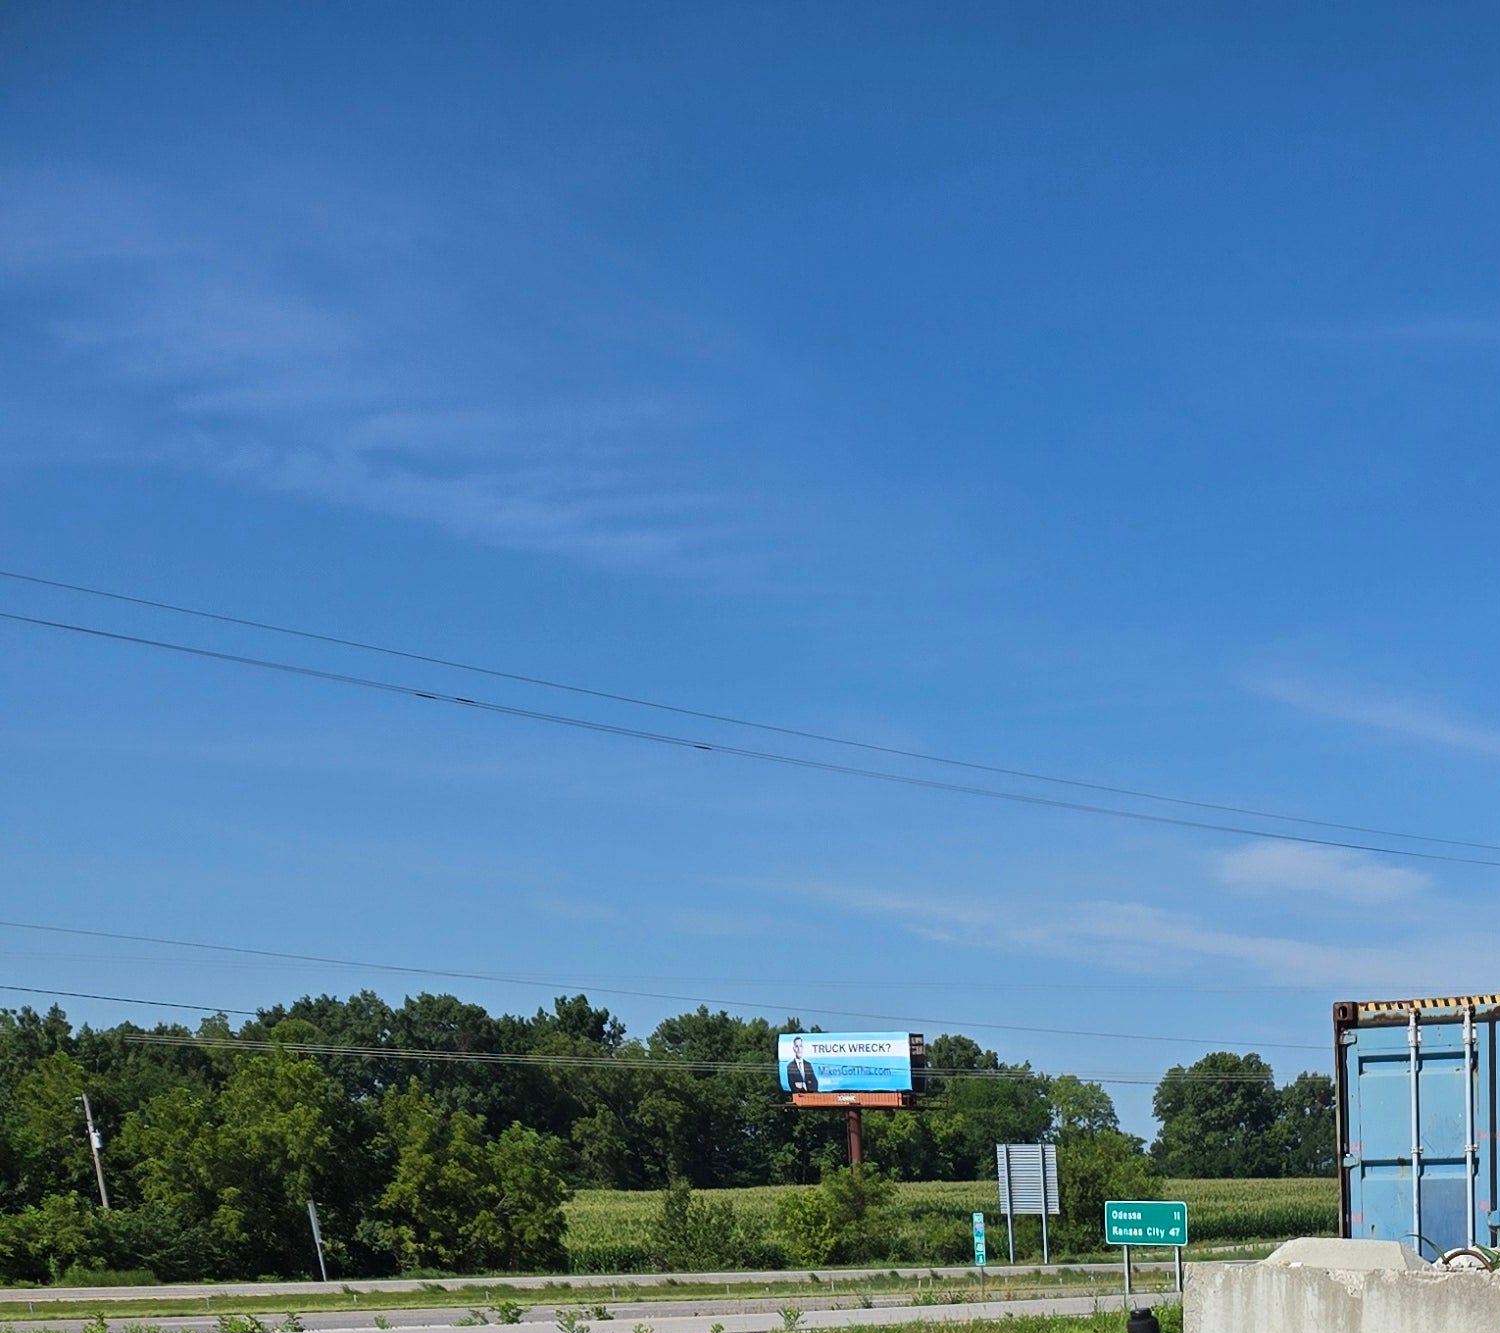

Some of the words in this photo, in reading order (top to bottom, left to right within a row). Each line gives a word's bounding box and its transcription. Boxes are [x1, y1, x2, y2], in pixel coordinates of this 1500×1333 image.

[812, 1044, 846, 1053] TRUCK
[848, 1043, 892, 1053] WRECK?
[1112, 1210, 1142, 1220] Odessa
[1112, 1227, 1143, 1237] Kansas
[1146, 1226, 1165, 1239] City
[1169, 1227, 1181, 1237] 47
